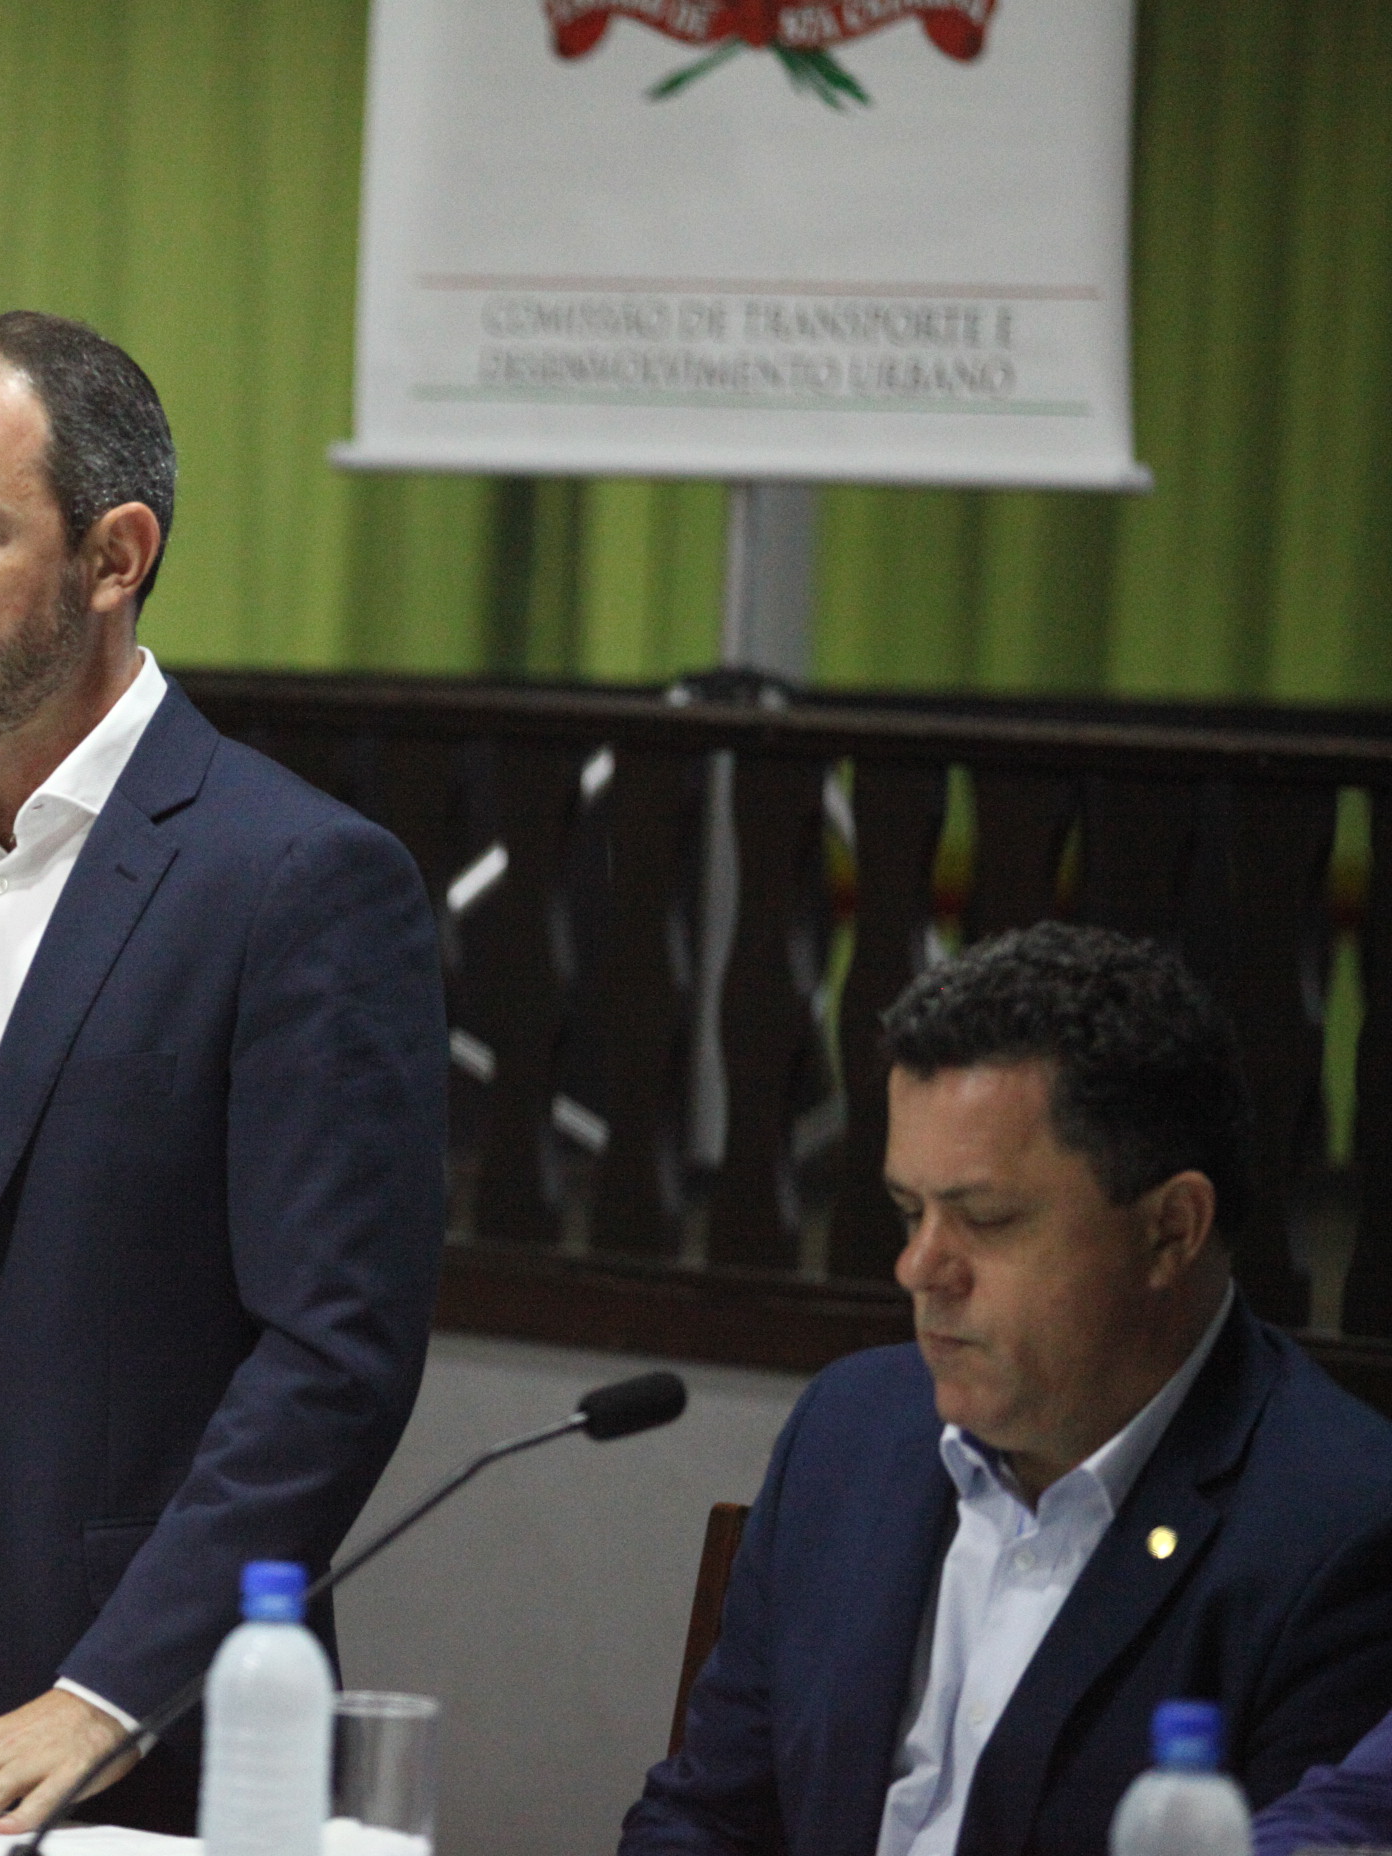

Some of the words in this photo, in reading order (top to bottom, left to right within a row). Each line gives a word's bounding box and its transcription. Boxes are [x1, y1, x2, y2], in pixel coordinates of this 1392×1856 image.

[678, 301, 726, 341] DE
[744, 302, 981, 347] TRANSPORTE
[850, 354, 1016, 396] URBANO
